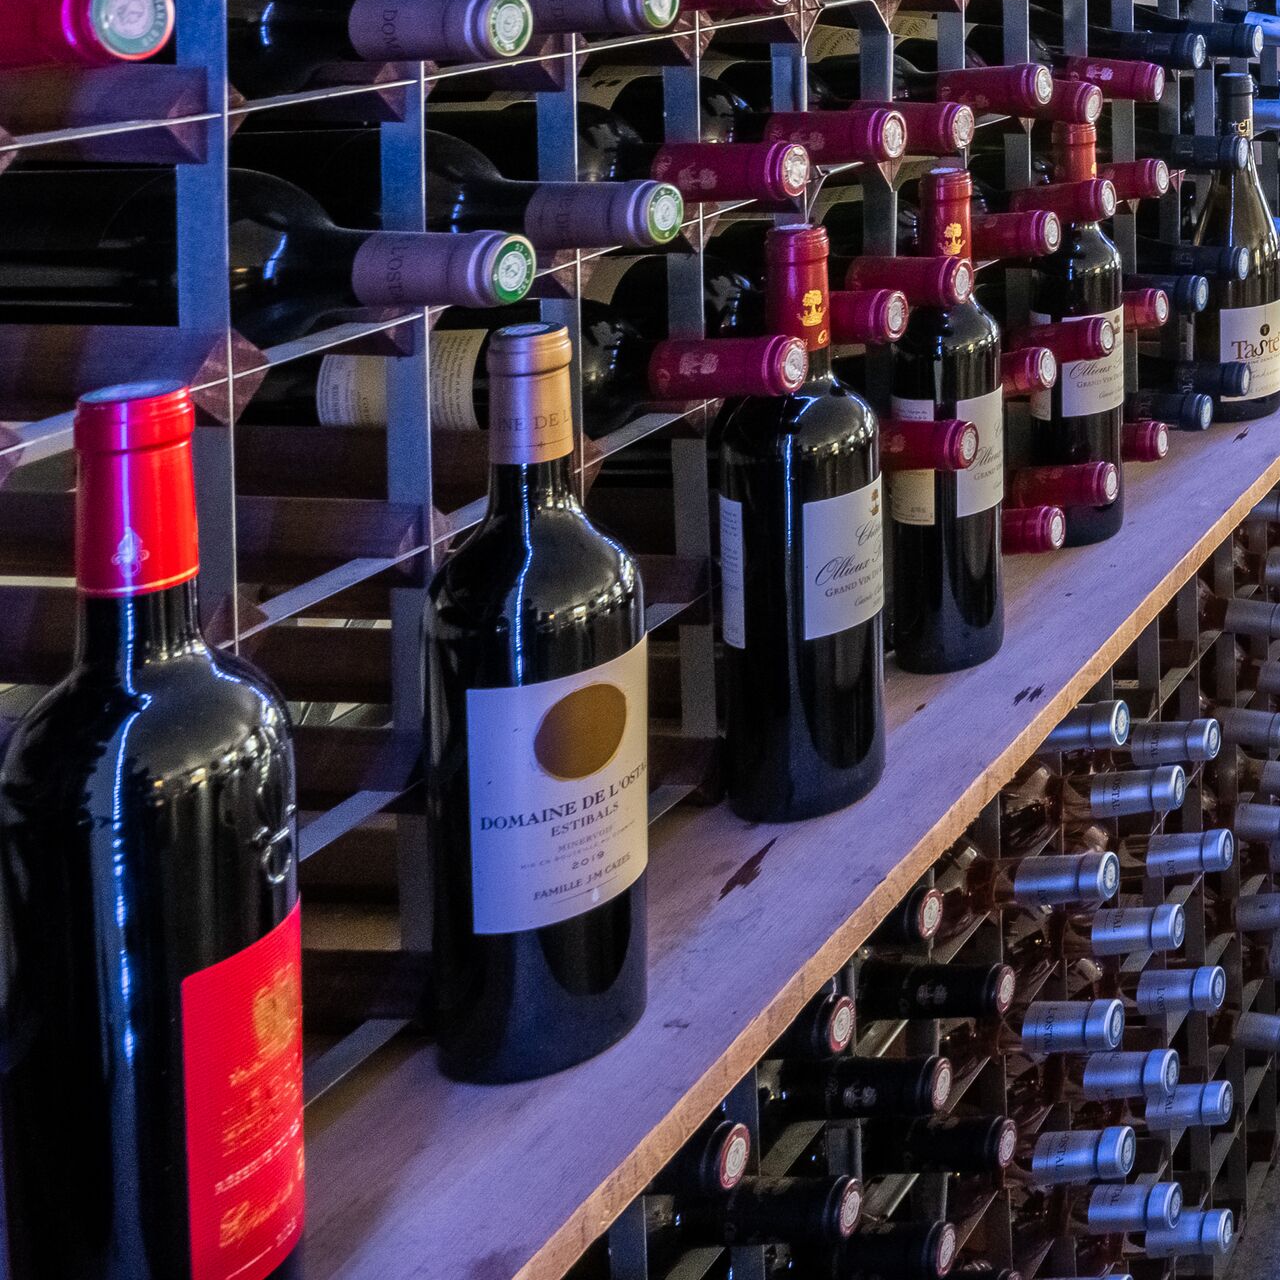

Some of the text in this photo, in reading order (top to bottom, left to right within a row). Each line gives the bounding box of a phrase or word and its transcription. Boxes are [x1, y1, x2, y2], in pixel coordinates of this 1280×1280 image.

[815, 553, 870, 586] Ollieux
[824, 577, 858, 598] GRAND
[480, 802, 577, 831] DOMAINE
[582, 788, 606, 811] DE
[550, 800, 620, 838] ESTIBALS
[570, 849, 606, 870] 2019
[533, 877, 584, 902] FAMILLE
